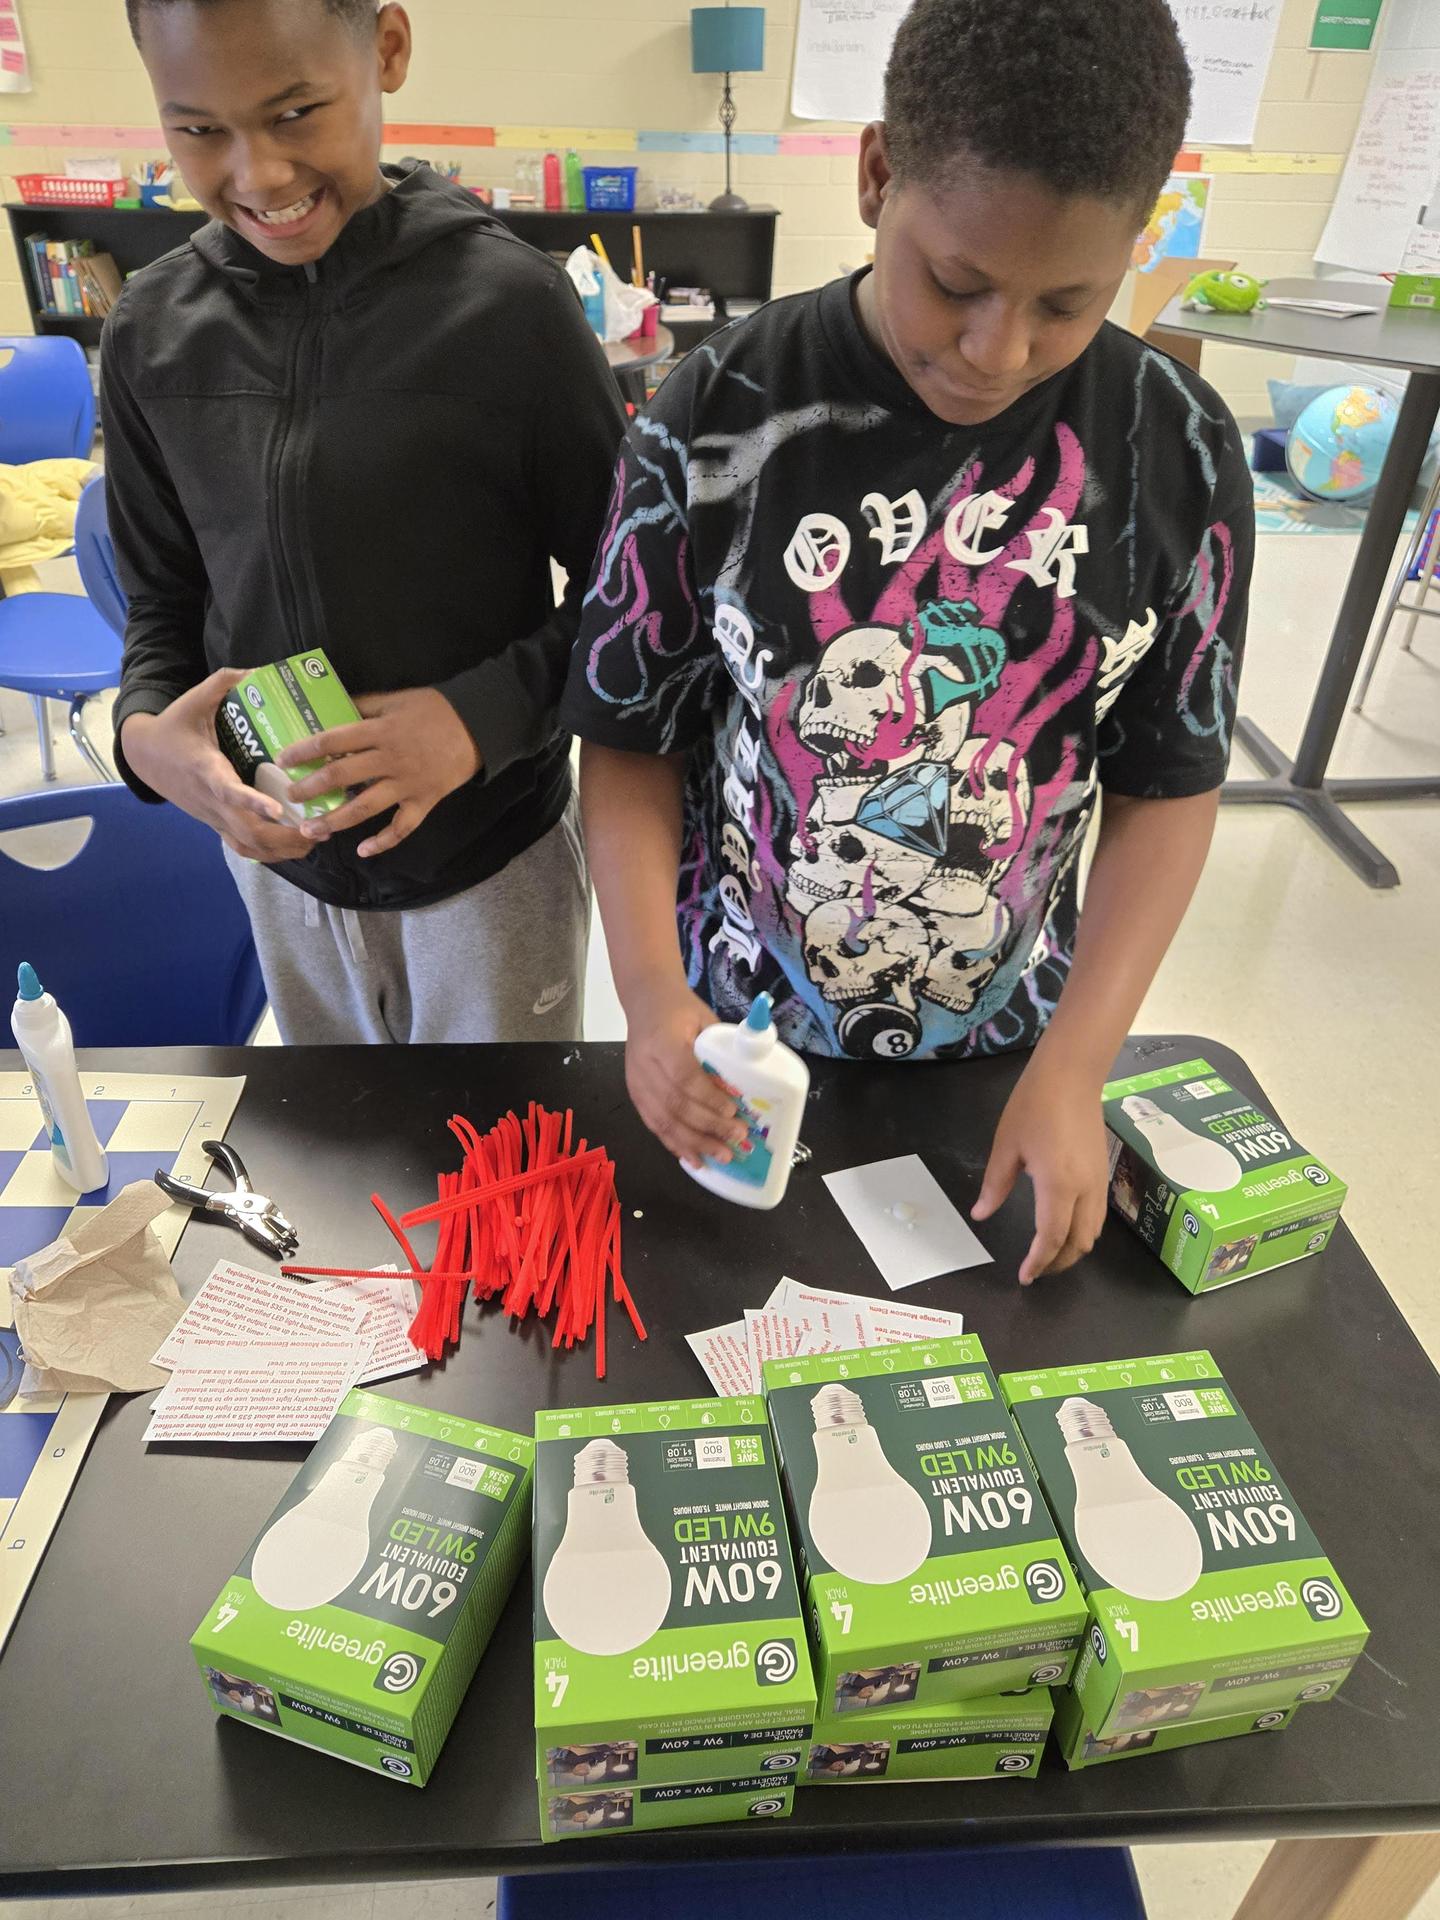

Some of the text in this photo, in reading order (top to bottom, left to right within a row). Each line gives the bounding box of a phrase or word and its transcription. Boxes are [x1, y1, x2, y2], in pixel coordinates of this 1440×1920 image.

[783, 489, 1090, 598] OVER
[226, 701, 264, 756] 60W
[540, 980, 568, 1004] NIKE
[888, 1032, 908, 1055] 8
[1207, 1116, 1242, 1133] LED
[1238, 1110, 1265, 1125] 9W
[1221, 1122, 1276, 1143] EQUIVALENT
[1233, 1131, 1291, 1161] 60W
[1200, 1204, 1219, 1219] 4
[211, 1273, 235, 1285] fixtures
[243, 1283, 254, 1291] the
[254, 1286, 272, 1297] bulbs
[278, 1295, 295, 1304] them
[310, 1304, 328, 1314] these
[328, 1311, 355, 1323] certified
[225, 1267, 256, 1282] Replacing
[254, 1278, 270, 1286] your
[275, 1284, 292, 1293] most
[291, 1288, 324, 1304] frequently
[324, 1299, 340, 1308] used
[339, 1303, 355, 1312] light
[200, 1291, 227, 1303] ENERGY
[226, 1299, 245, 1309] STAR
[244, 1306, 272, 1317] certified
[270, 1313, 284, 1321] LED
[284, 1317, 299, 1327] light
[298, 1321, 317, 1332] bulbs
[205, 1282, 224, 1292] lights
[236, 1293, 251, 1301] save
[251, 1297, 270, 1307] about
[269, 1302, 283, 1311] $35
[286, 1309, 302, 1317] year
[309, 1316, 332, 1327] energy
[331, 1322, 350, 1332] costs.
[897, 1388, 922, 1398] $1.08
[931, 1383, 950, 1394] 800
[1173, 1397, 1193, 1407] 800
[667, 1447, 692, 1457] $1.08
[702, 1444, 722, 1454] 800
[737, 1452, 758, 1462] SAVE
[920, 1442, 1016, 1476] 9W LED
[458, 1465, 476, 1476] 800
[931, 1467, 1024, 1496] EQUIVALENT
[1176, 1459, 1271, 1489] 9W LED
[715, 1503, 732, 1511] WHITE
[732, 1501, 751, 1510] BRIGHT
[1191, 1484, 1282, 1510] EQUIVALENT
[673, 1506, 691, 1514] HOURS
[943, 1487, 1032, 1535] 60W
[674, 1512, 774, 1542] 9W LED
[1206, 1503, 1295, 1550] 60W
[389, 1518, 477, 1562] 9W LED
[679, 1539, 777, 1563] EQUIVALENT
[379, 1541, 467, 1582] EQUIVALENT
[358, 1560, 456, 1617] 60W
[683, 1560, 781, 1606] 60W
[824, 1586, 847, 1600] PACK
[910, 1564, 1019, 1605] greenlite
[224, 1591, 245, 1604] PACK
[1190, 1581, 1297, 1622] greenlite
[211, 1602, 238, 1632] 4
[830, 1601, 853, 1633] 4
[1106, 1604, 1129, 1617] PACK
[286, 1619, 386, 1664] greenlite
[1114, 1618, 1138, 1651] 4
[544, 1657, 566, 1669] PACK
[633, 1640, 749, 1681] greenlite
[942, 1651, 999, 1667] 9W 60W
[545, 1670, 569, 1707] 4
[291, 1701, 340, 1724] 9W 60W
[661, 1736, 723, 1749] 9W 60W
[910, 1740, 936, 1748] 60W
[654, 1785, 712, 1797] 9W 60W
